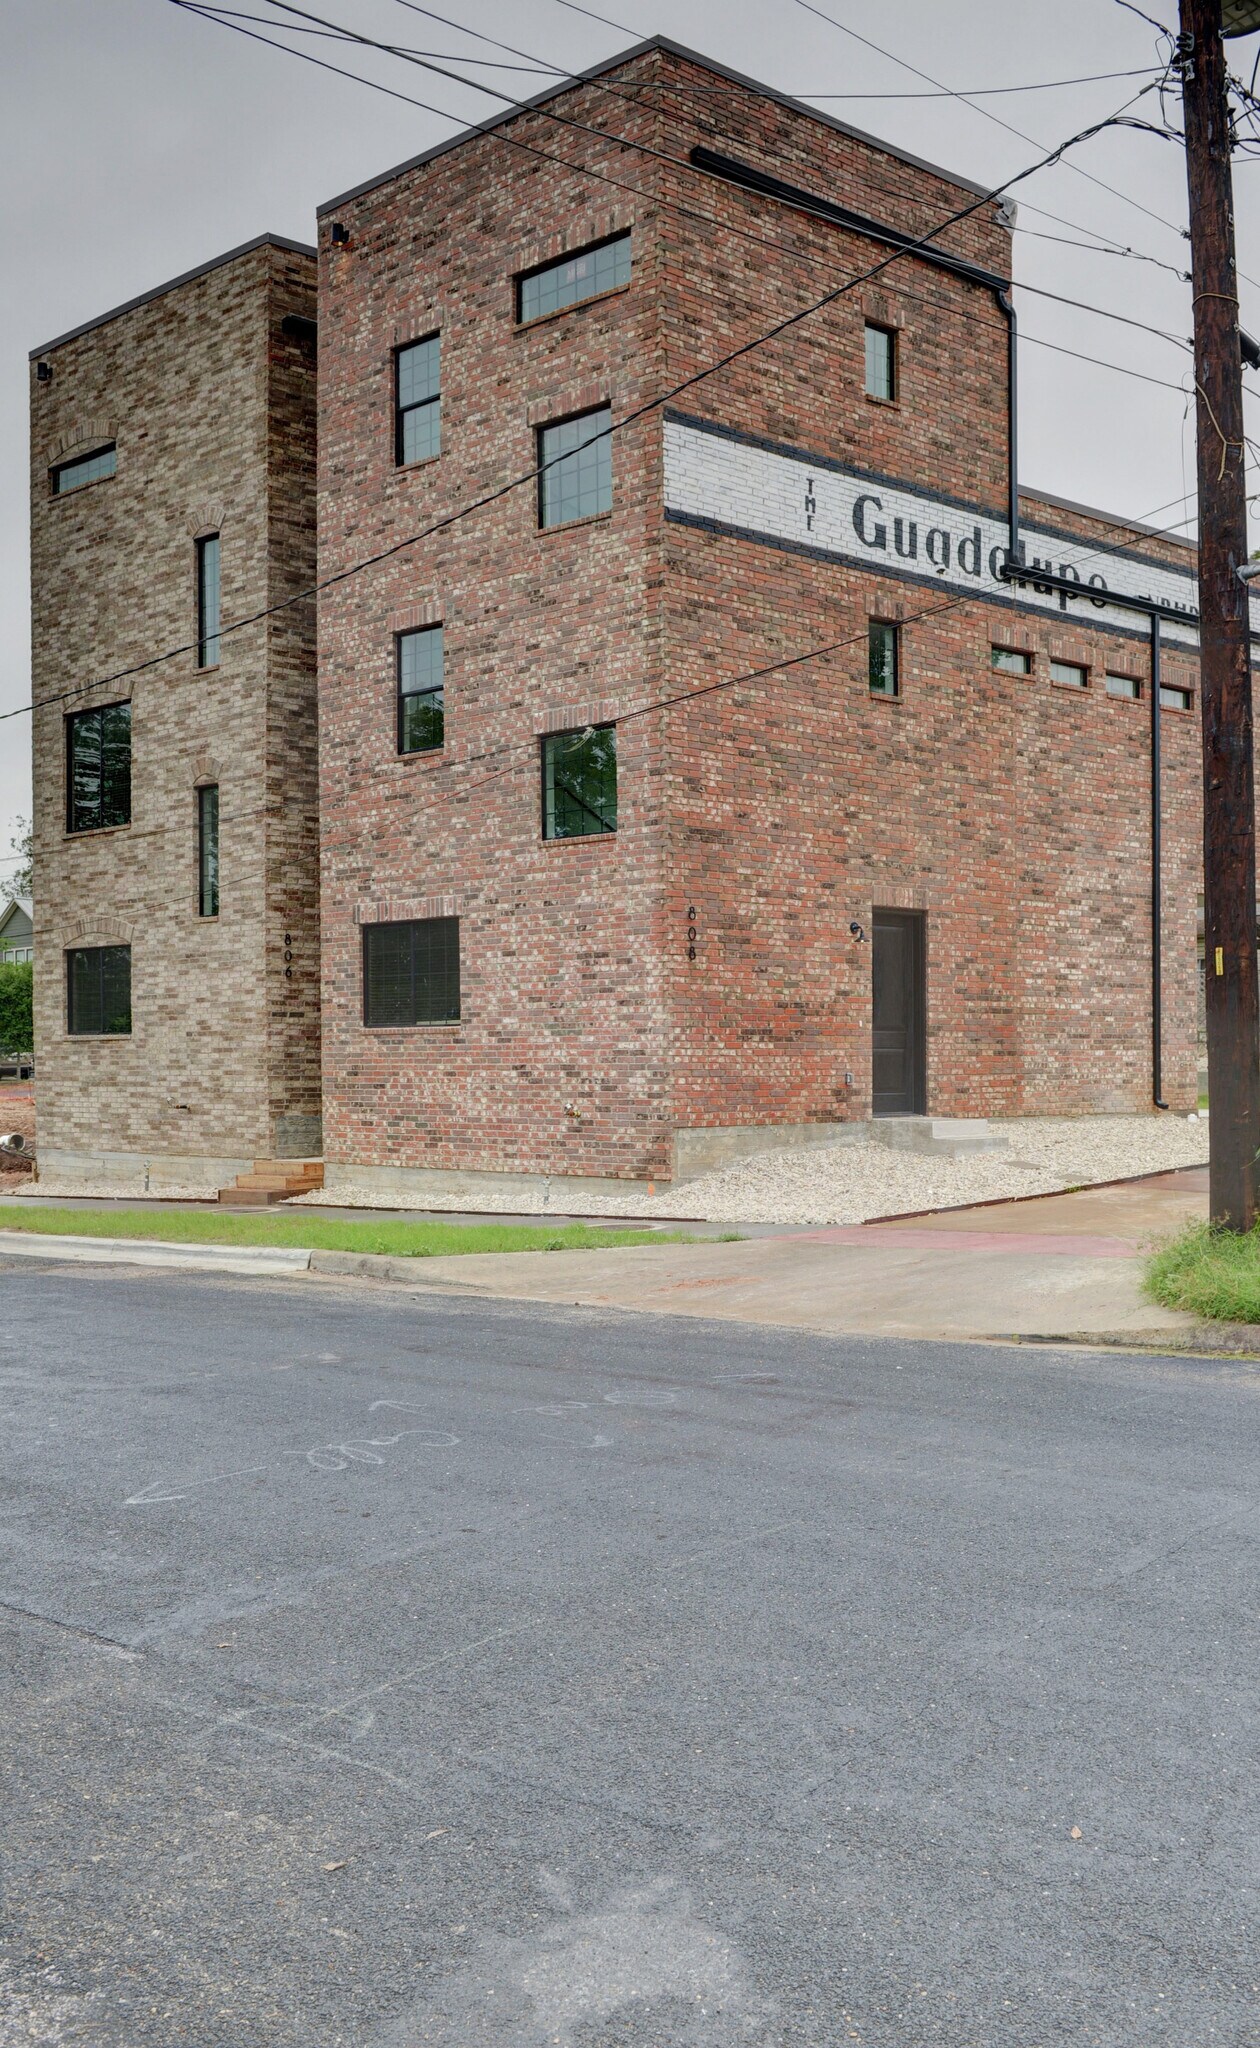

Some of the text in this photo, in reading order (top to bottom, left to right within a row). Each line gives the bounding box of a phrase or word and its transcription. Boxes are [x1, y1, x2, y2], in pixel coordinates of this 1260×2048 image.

[805, 478, 816, 532] THE
[284, 933, 293, 978] 806
[688, 906, 697, 961] 808
